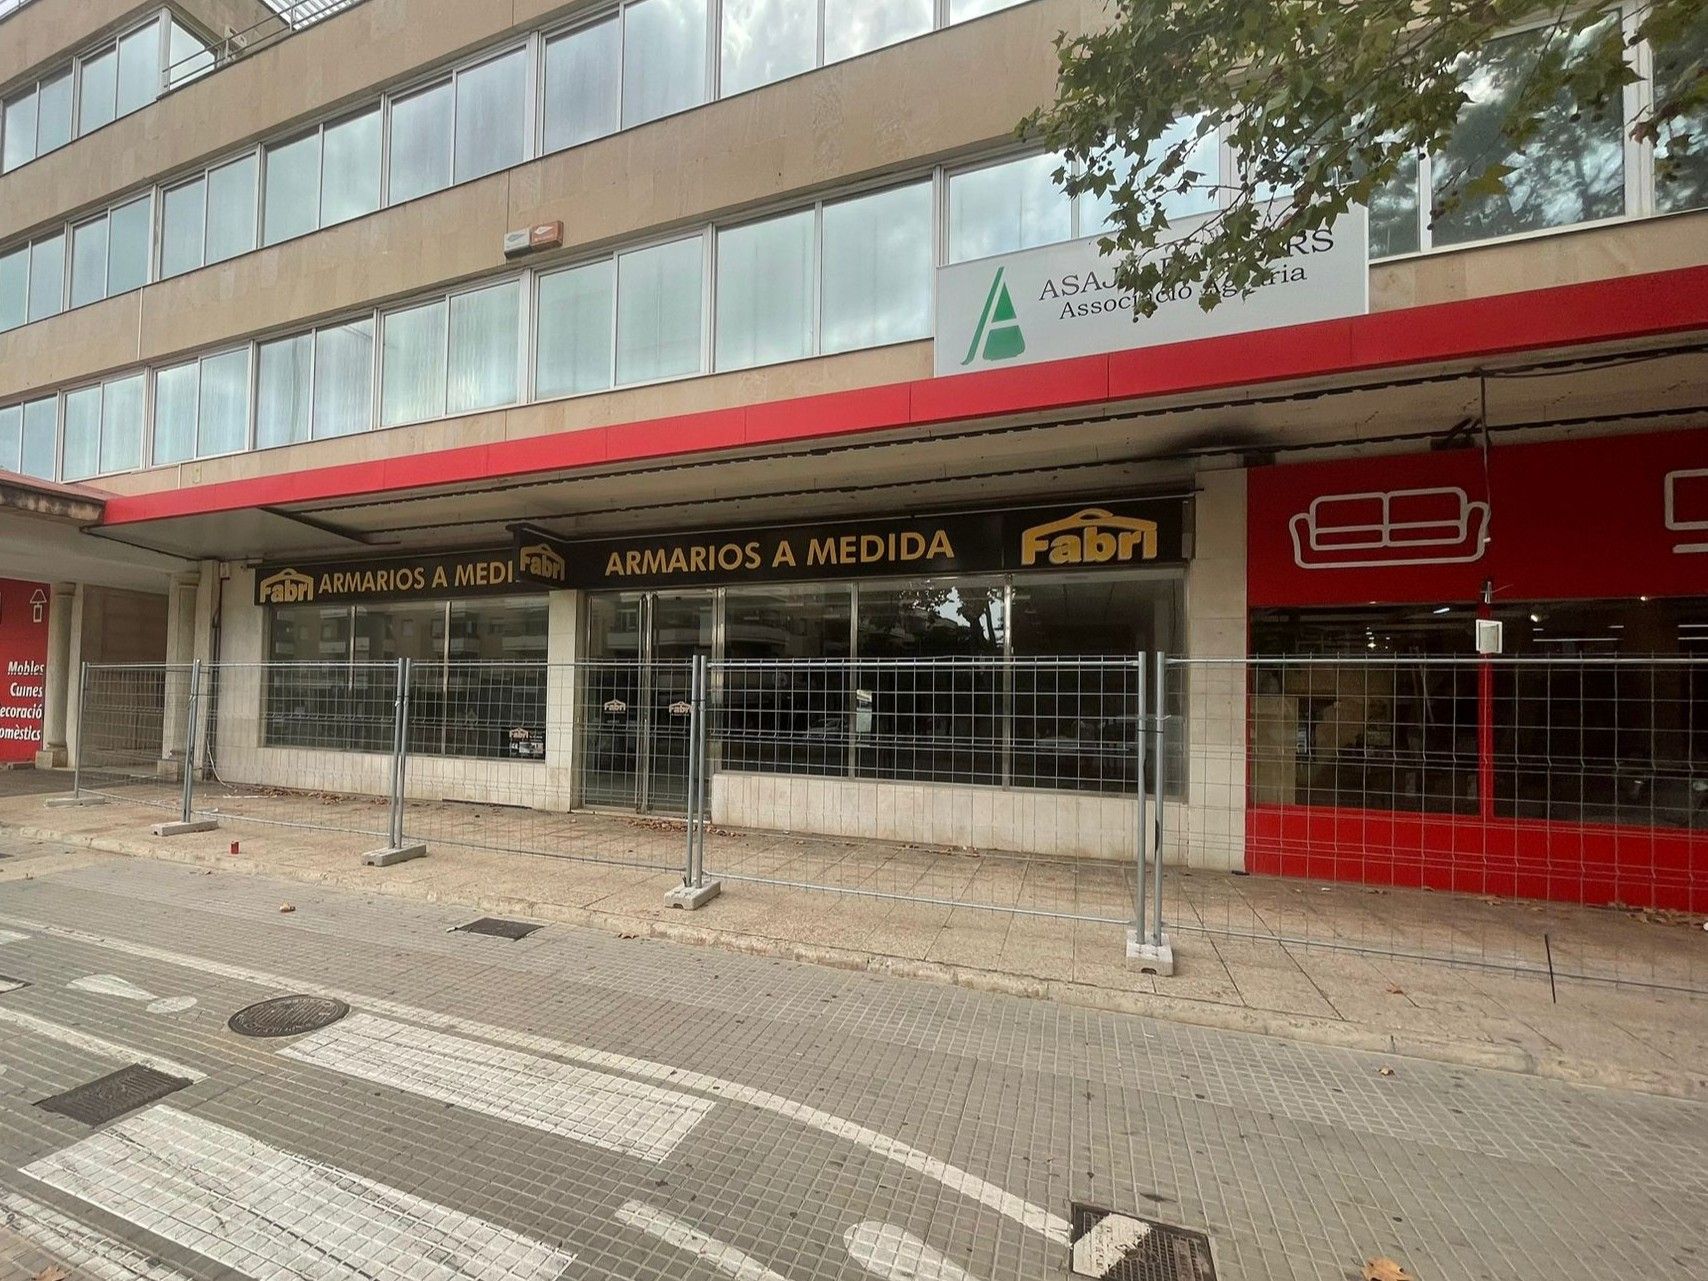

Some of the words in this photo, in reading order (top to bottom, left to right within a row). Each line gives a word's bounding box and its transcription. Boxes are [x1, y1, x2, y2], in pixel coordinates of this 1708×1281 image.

[1039, 265, 1119, 301] ASAJ
[604, 542, 762, 577] ARMARIOS
[771, 540, 797, 568] A
[806, 529, 955, 566] MEDIDA
[1021, 508, 1158, 566] Fabri
[318, 567, 425, 594] ARMARIOS
[431, 565, 448, 588] A
[454, 560, 515, 587] MEDI
[519, 543, 566, 581] Fabri
[259, 567, 314, 603] Fabri
[7, 659, 45, 676] Mobles
[9, 681, 43, 698] Cuines
[0, 703, 43, 719] ecoració
